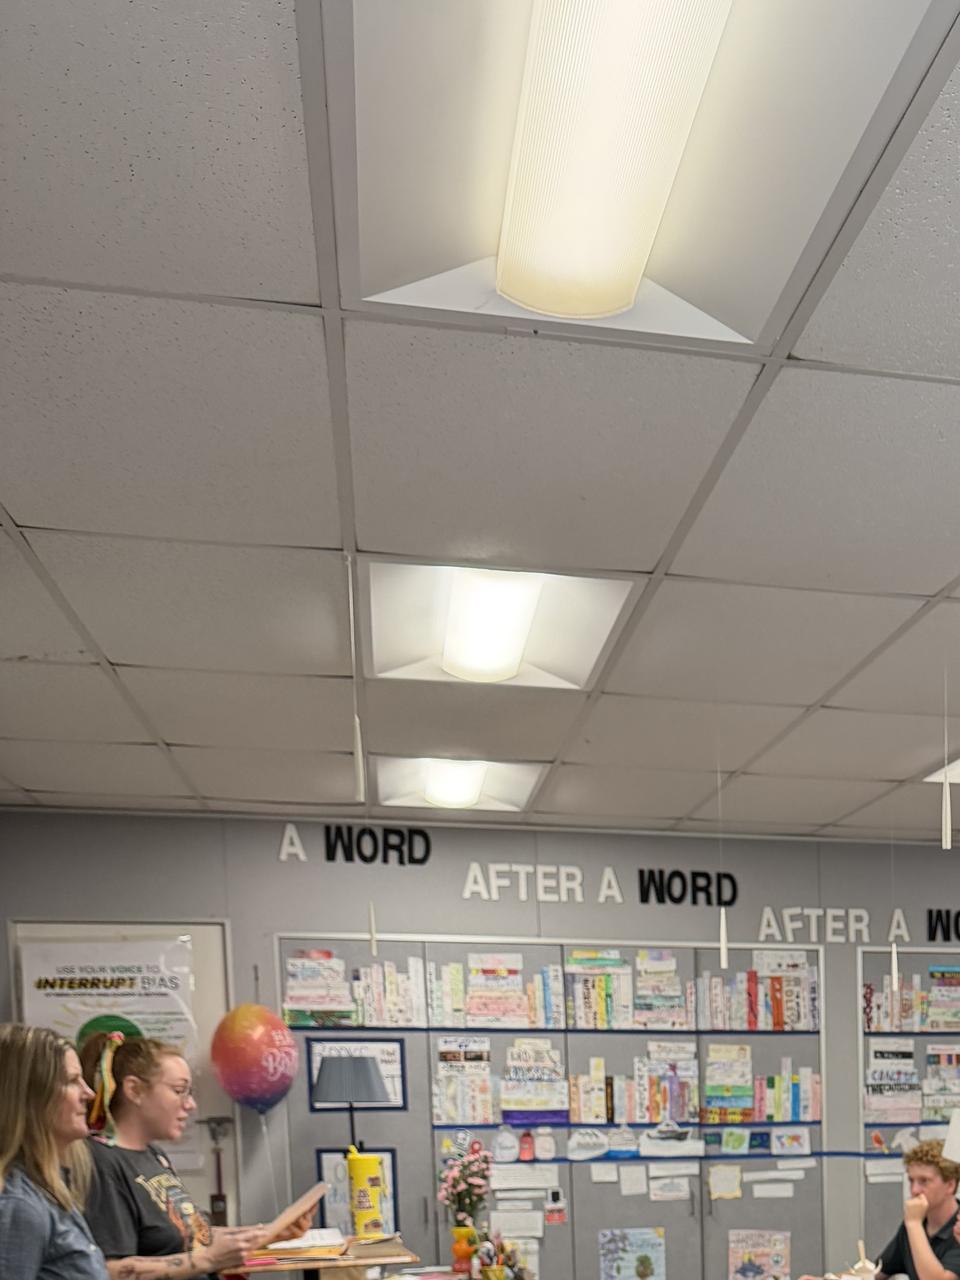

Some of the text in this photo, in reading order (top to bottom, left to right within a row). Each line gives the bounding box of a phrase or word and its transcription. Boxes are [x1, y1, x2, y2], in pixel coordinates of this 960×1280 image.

[279, 823, 432, 865] A WORD
[462, 861, 738, 907] AFTER A WORD
[758, 906, 870, 944] AFTER
[888, 908, 911, 943] A
[36, 975, 179, 990] INTERRUPT BIAS
